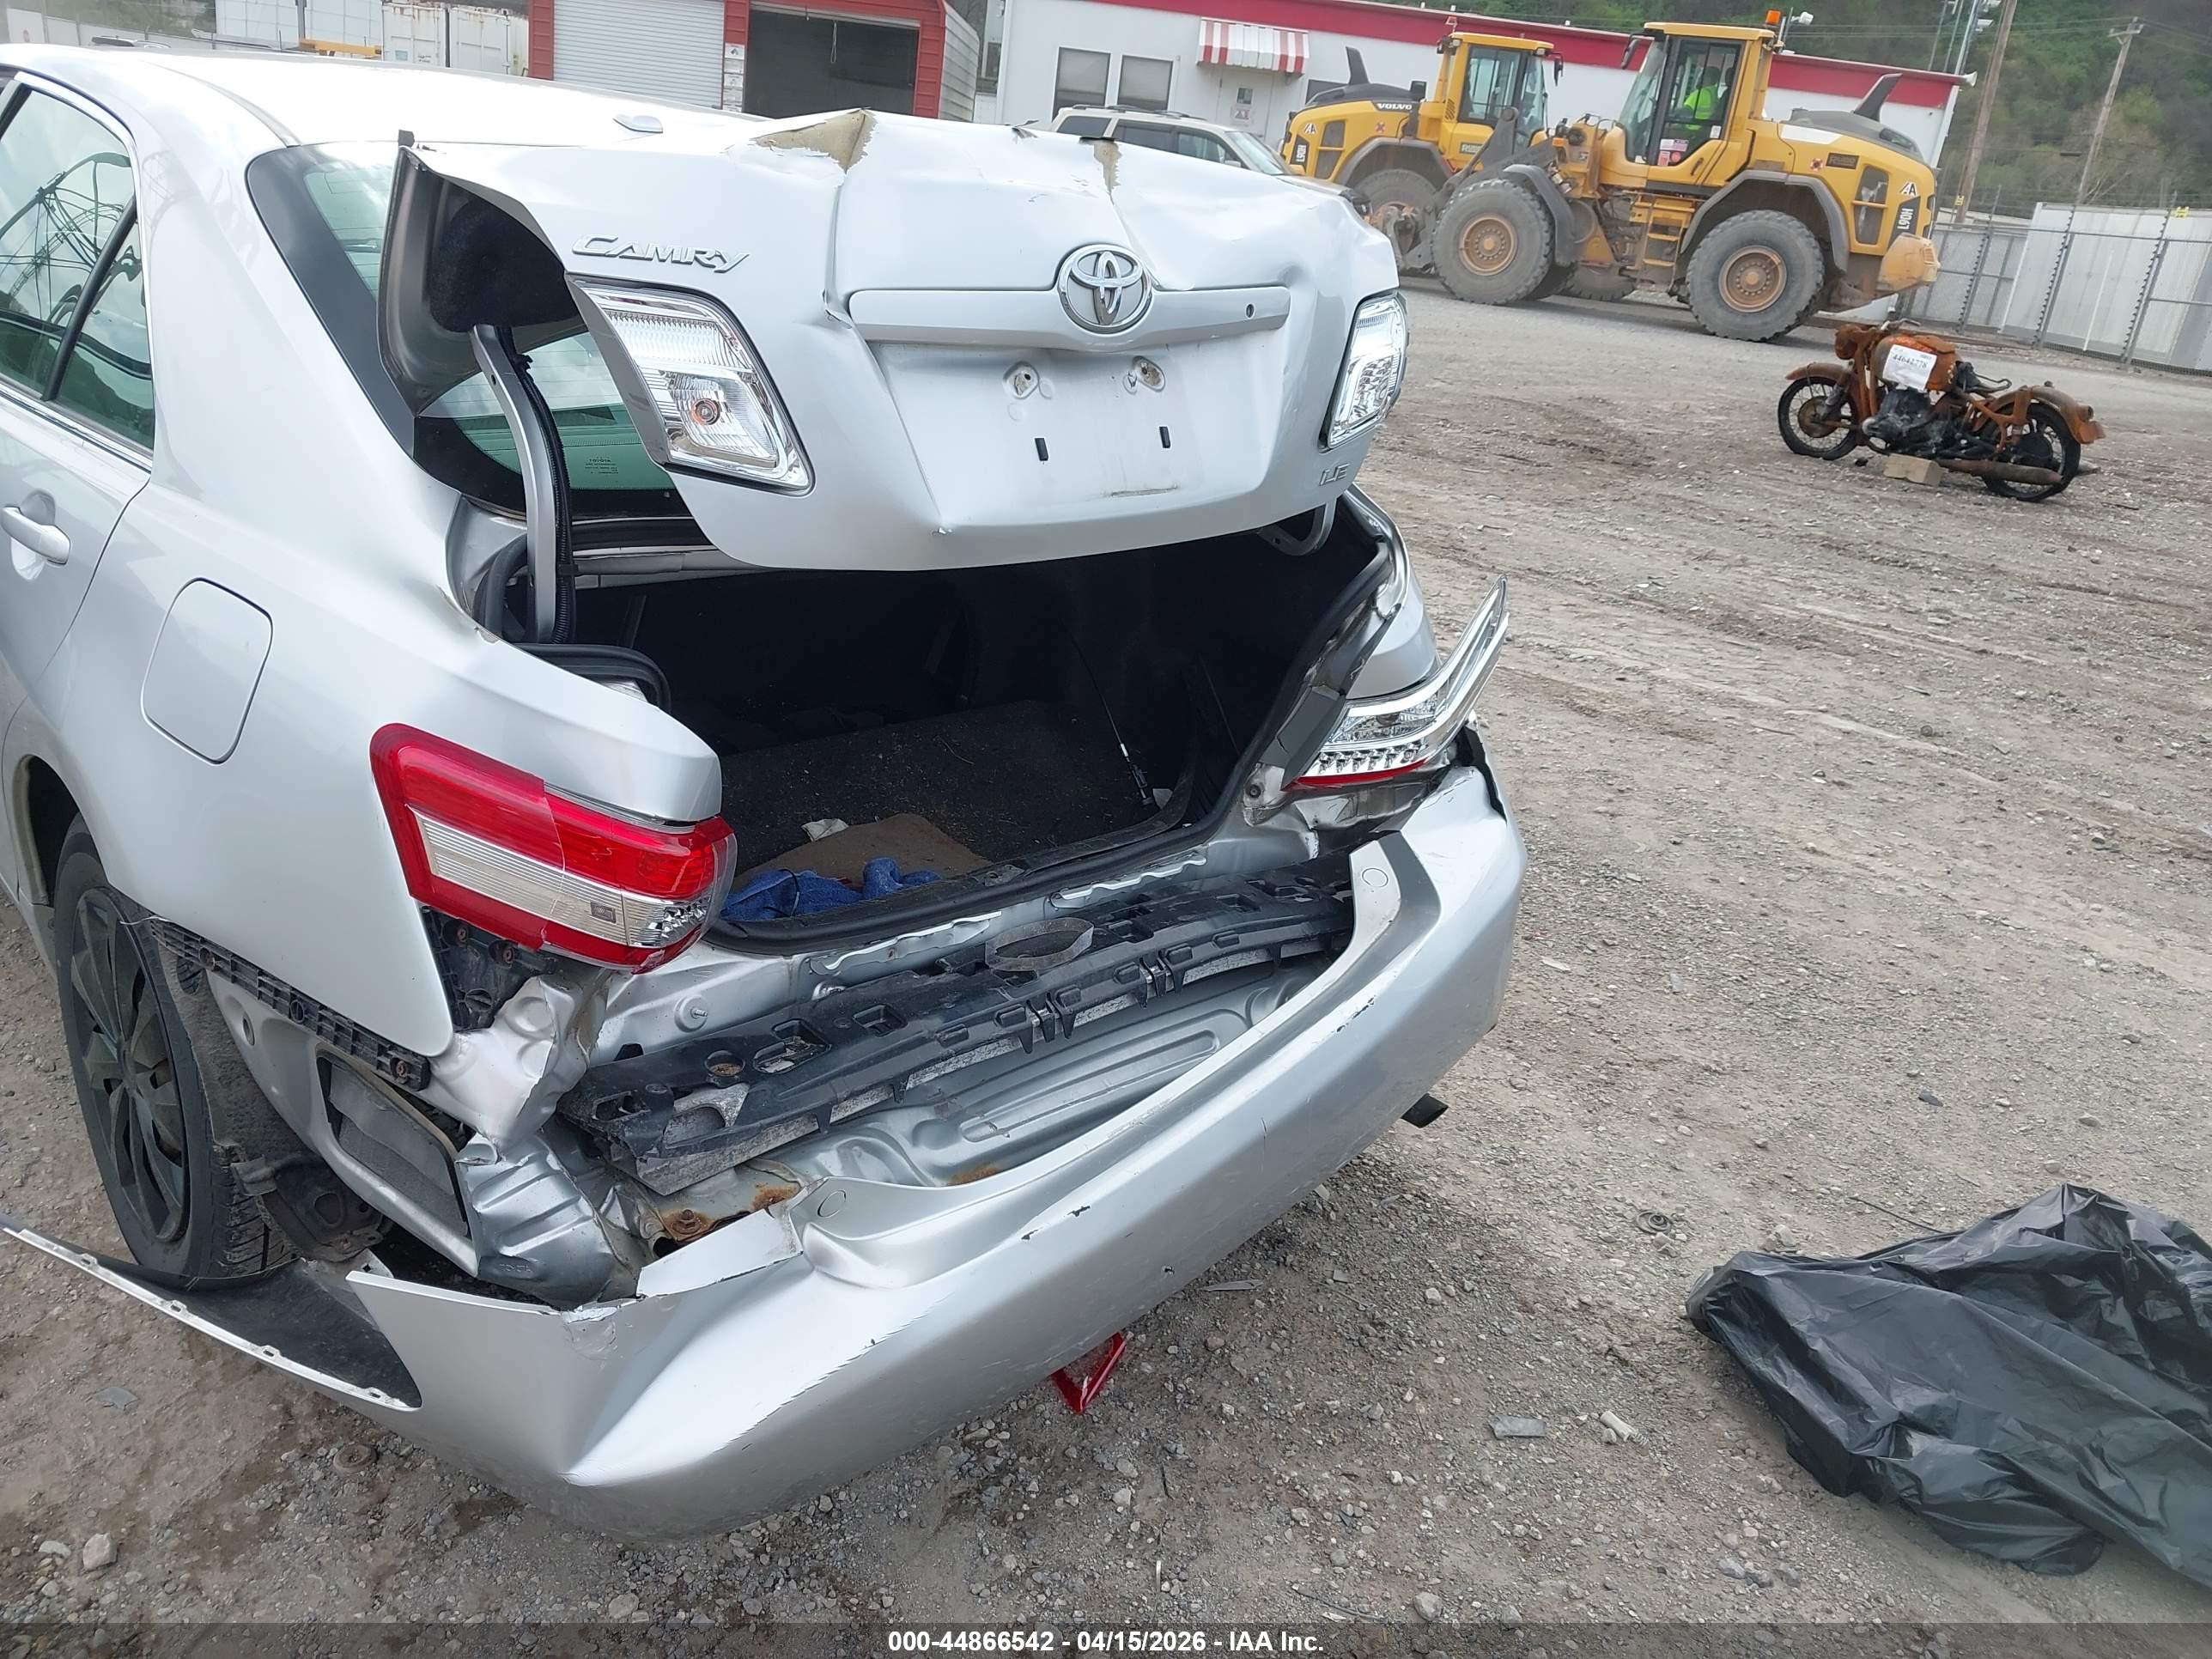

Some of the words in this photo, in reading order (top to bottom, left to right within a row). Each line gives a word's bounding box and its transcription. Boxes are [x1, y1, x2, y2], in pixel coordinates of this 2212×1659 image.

[1376, 102, 1413, 111] VOLVO
[1897, 208, 1914, 229] L90H
[571, 234, 750, 274] CAMRY
[1319, 462, 1351, 486] LE
